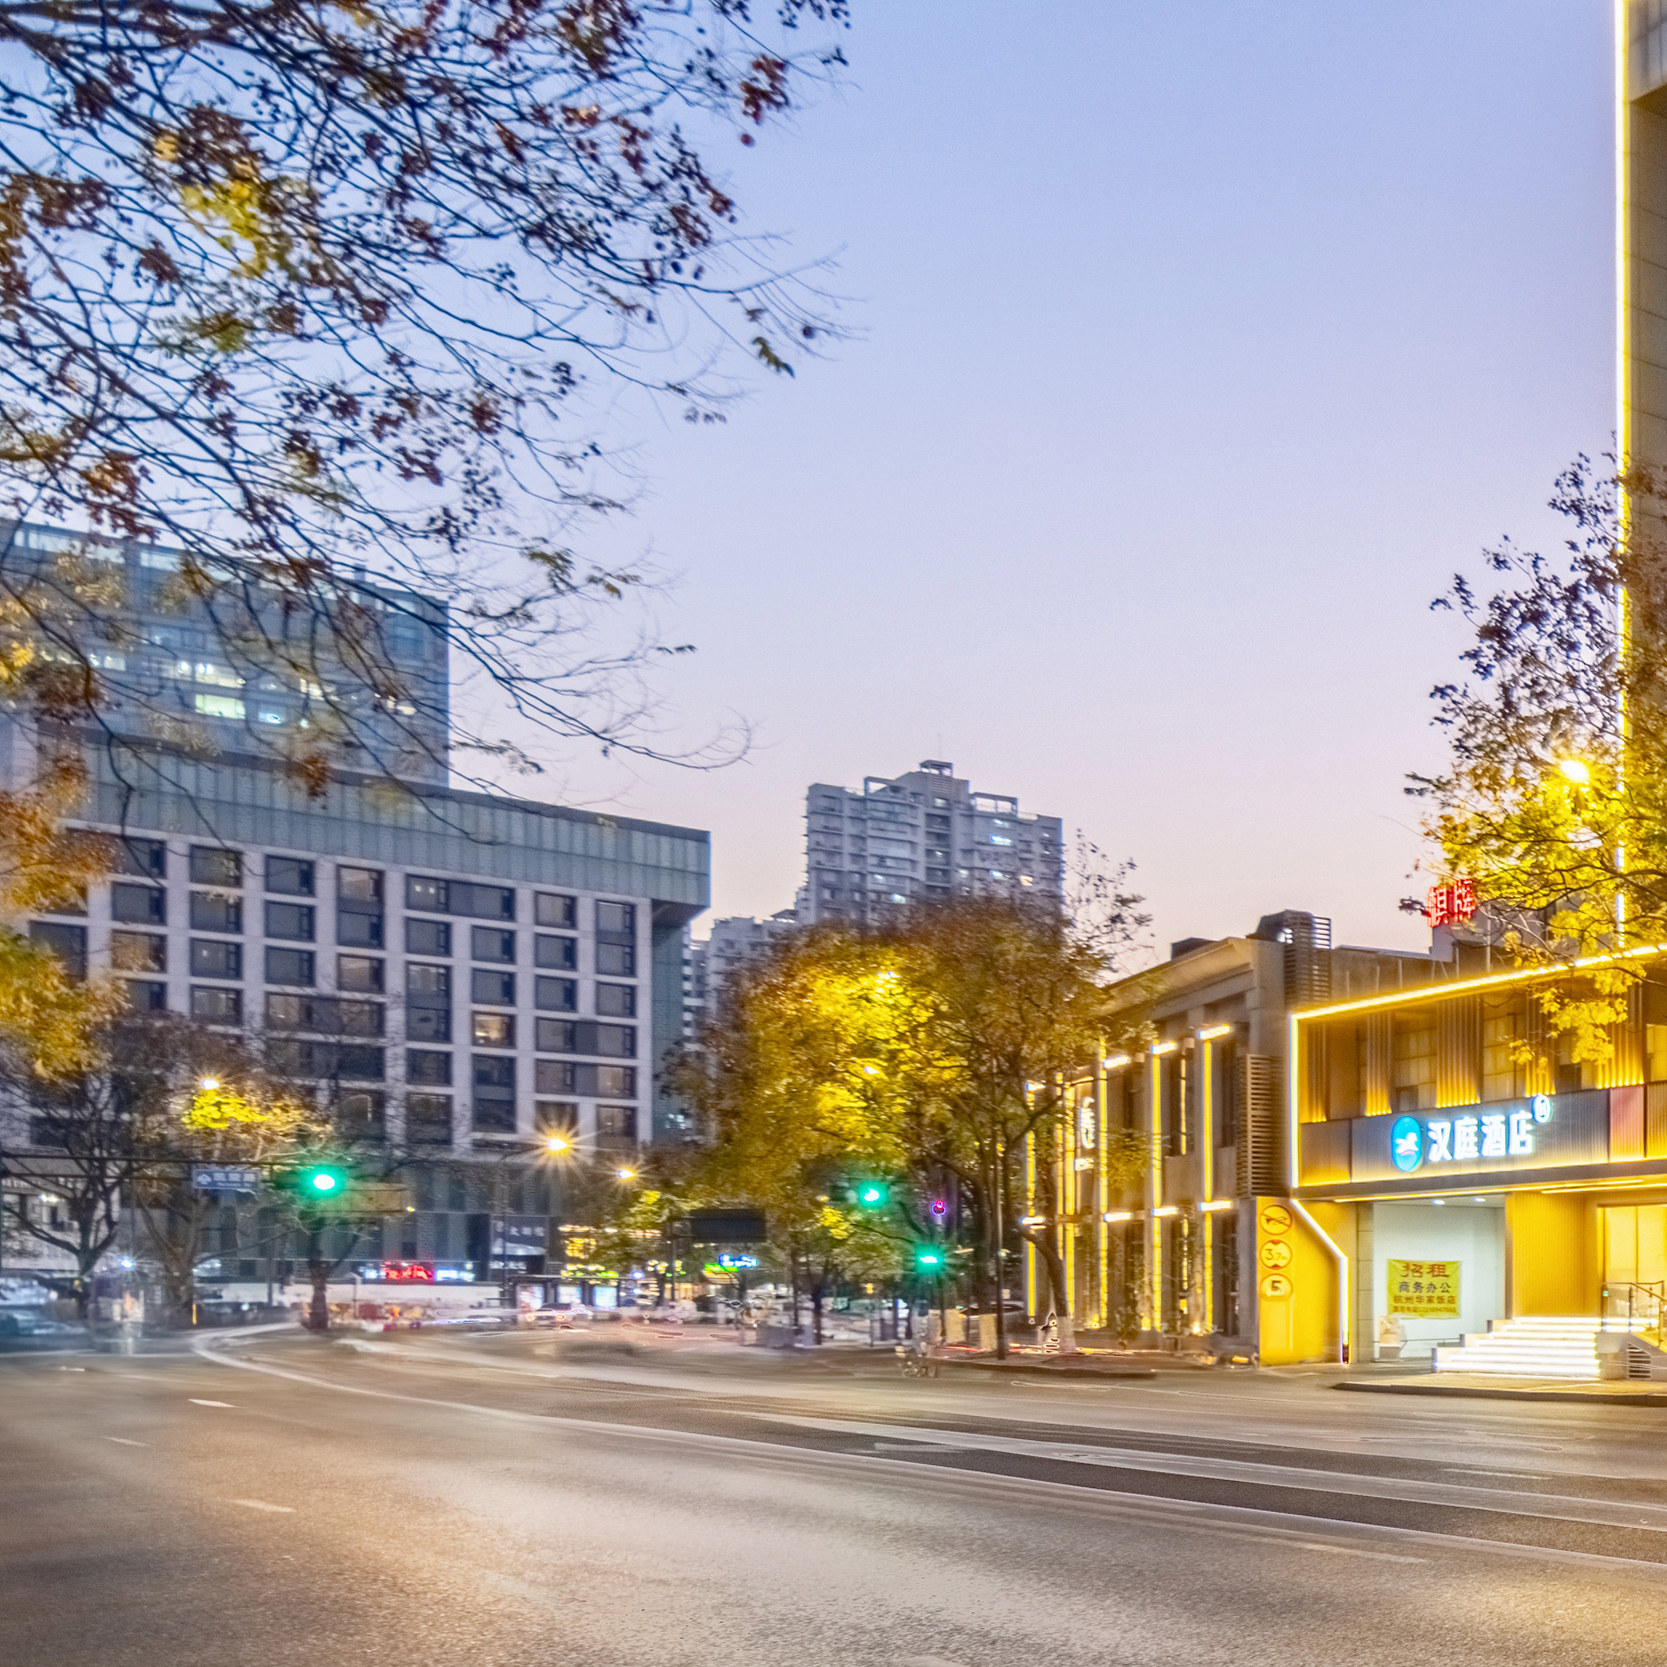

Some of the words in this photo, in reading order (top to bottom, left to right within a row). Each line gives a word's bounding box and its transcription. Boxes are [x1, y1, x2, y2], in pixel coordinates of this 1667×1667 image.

[1427, 1110, 1533, 1163] 汉庭酒店
[1400, 1262, 1450, 1278] 招租
[1399, 1281, 1451, 1293] 商务办公
